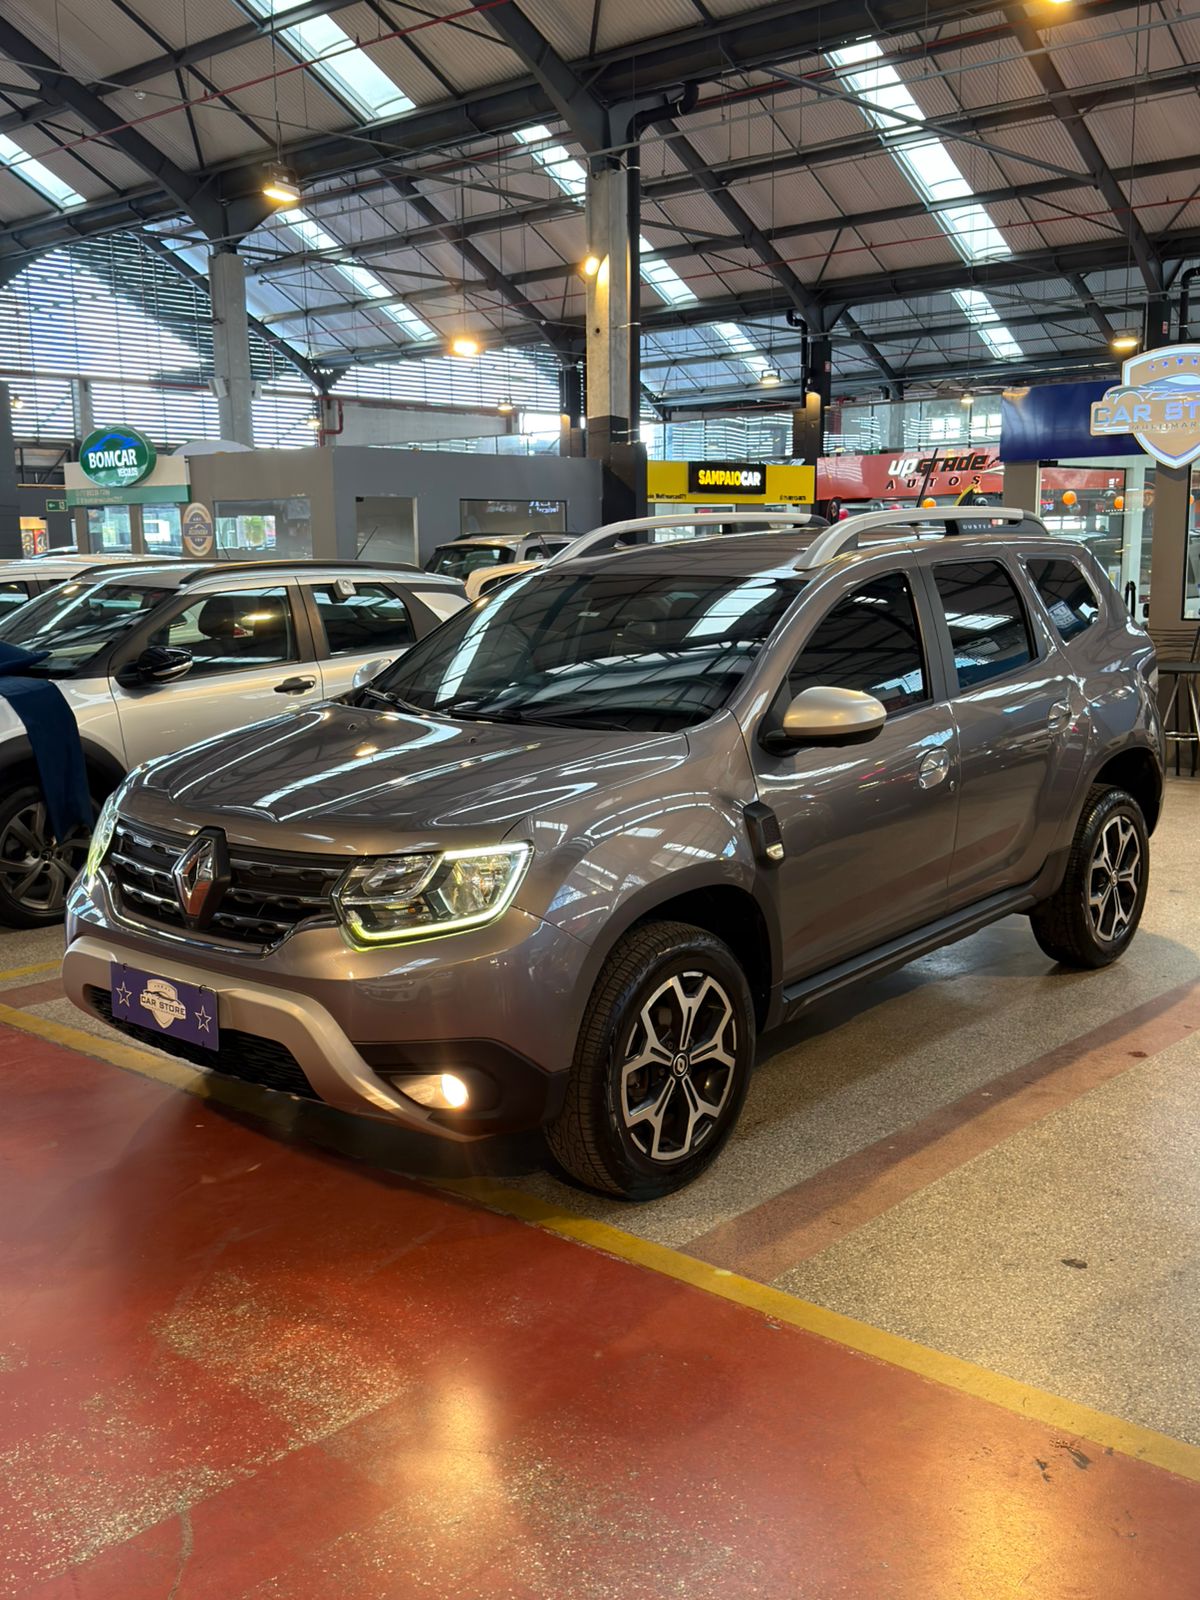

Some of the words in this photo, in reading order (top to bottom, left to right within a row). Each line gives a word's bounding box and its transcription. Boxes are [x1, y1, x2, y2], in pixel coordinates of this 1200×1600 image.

[1094, 403, 1152, 424] CAR
[88, 449, 137, 469] BOMCAR
[886, 475, 982, 490] AUTOS
[141, 996, 157, 1006] CAR
[159, 1001, 185, 1016] STORE
